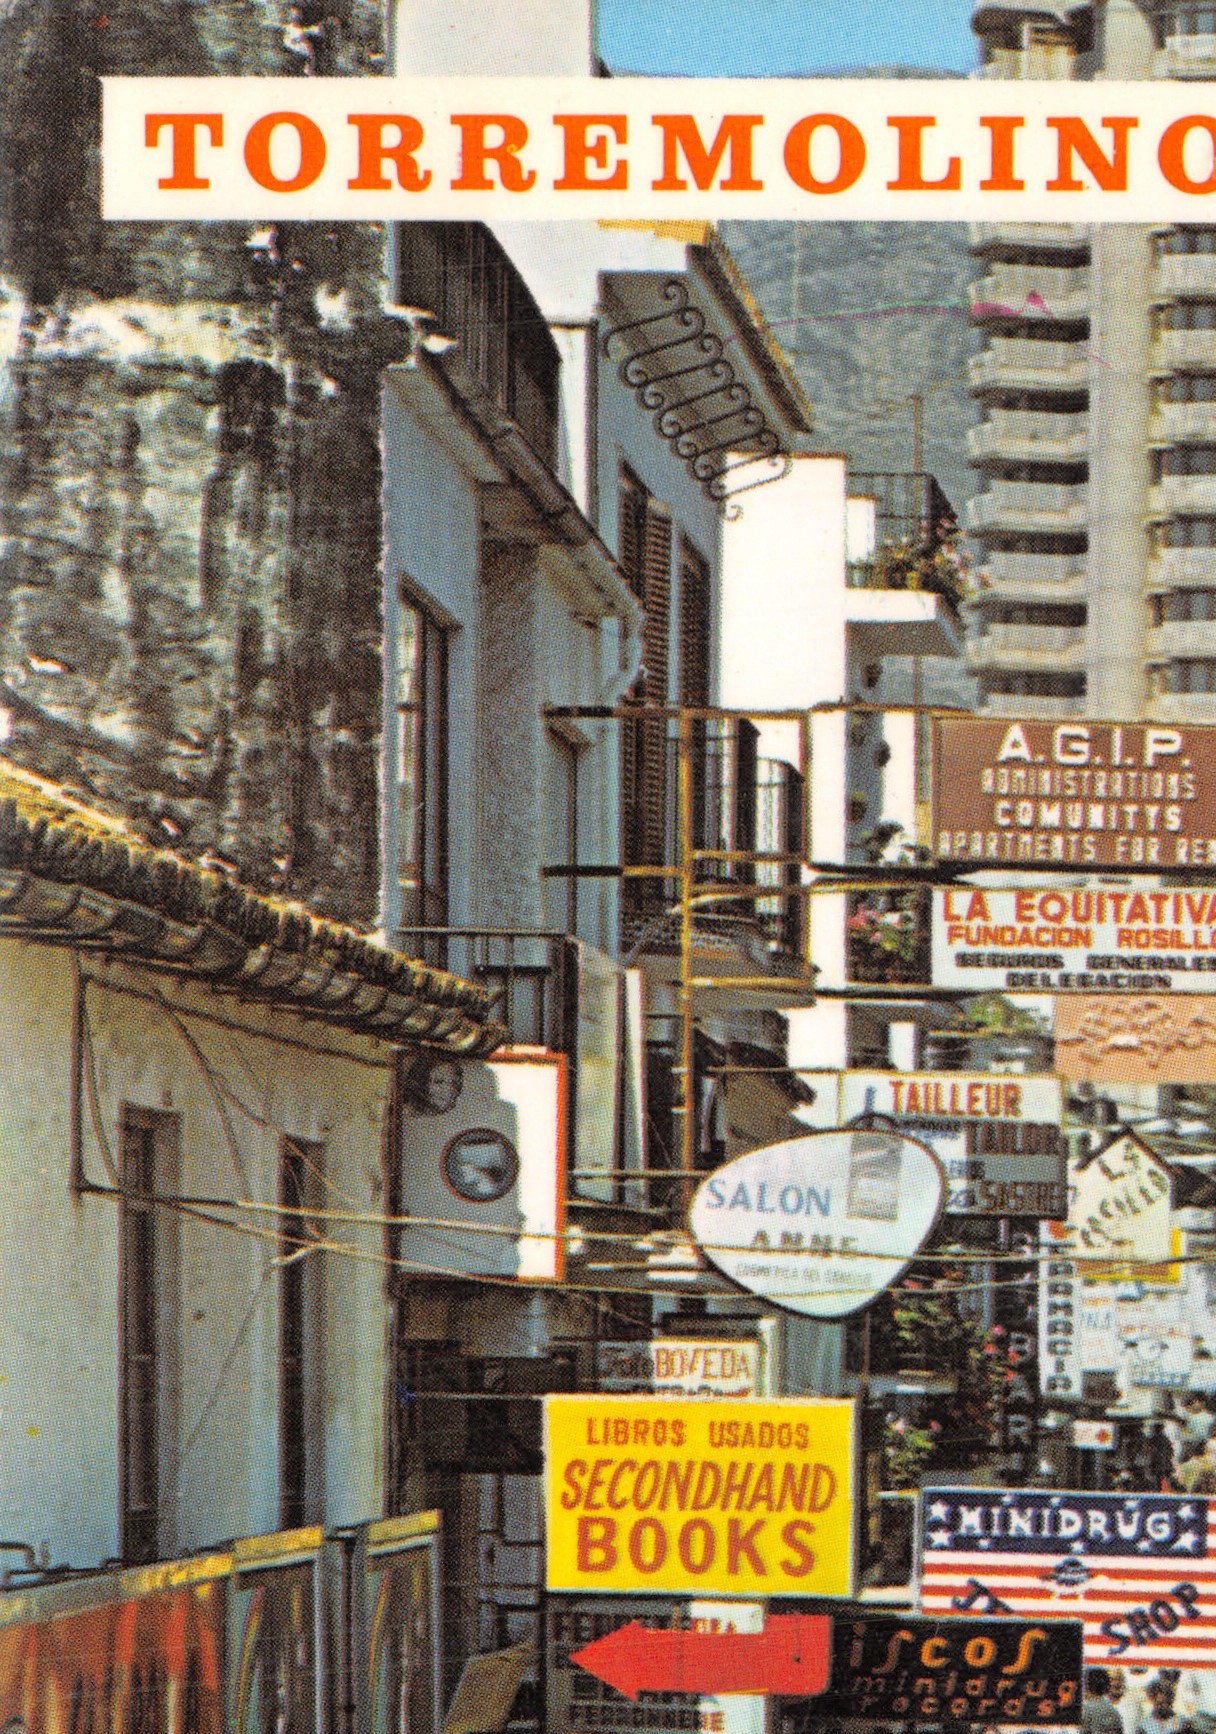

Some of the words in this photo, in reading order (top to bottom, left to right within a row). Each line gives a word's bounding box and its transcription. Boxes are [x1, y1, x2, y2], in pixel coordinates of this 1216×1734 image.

[996, 724, 1192, 767] A.G.I.P.
[937, 831, 1098, 862] APARTMENTS
[1117, 836, 1160, 863] FOR
[942, 891, 991, 924] LA
[946, 925, 1092, 949] FUNDACION
[1004, 971, 1172, 989] DELEGACION
[889, 1080, 1022, 1118] TAILLEUR
[705, 1179, 832, 1217] SALON
[752, 1230, 857, 1258] ANNE
[655, 1347, 752, 1380] BOVEDA
[585, 1417, 687, 1449] LIBROS
[708, 1419, 811, 1451] USADOS
[560, 1458, 838, 1514] SECONDHAND
[957, 1504, 1174, 1542] MINIDRUG
[573, 1516, 817, 1577] BOOKS
[1101, 1581, 1202, 1657] SHOP
[849, 1622, 1047, 1676] iscos
[853, 1668, 1078, 1707] minidrug
[859, 1695, 1055, 1717] records
